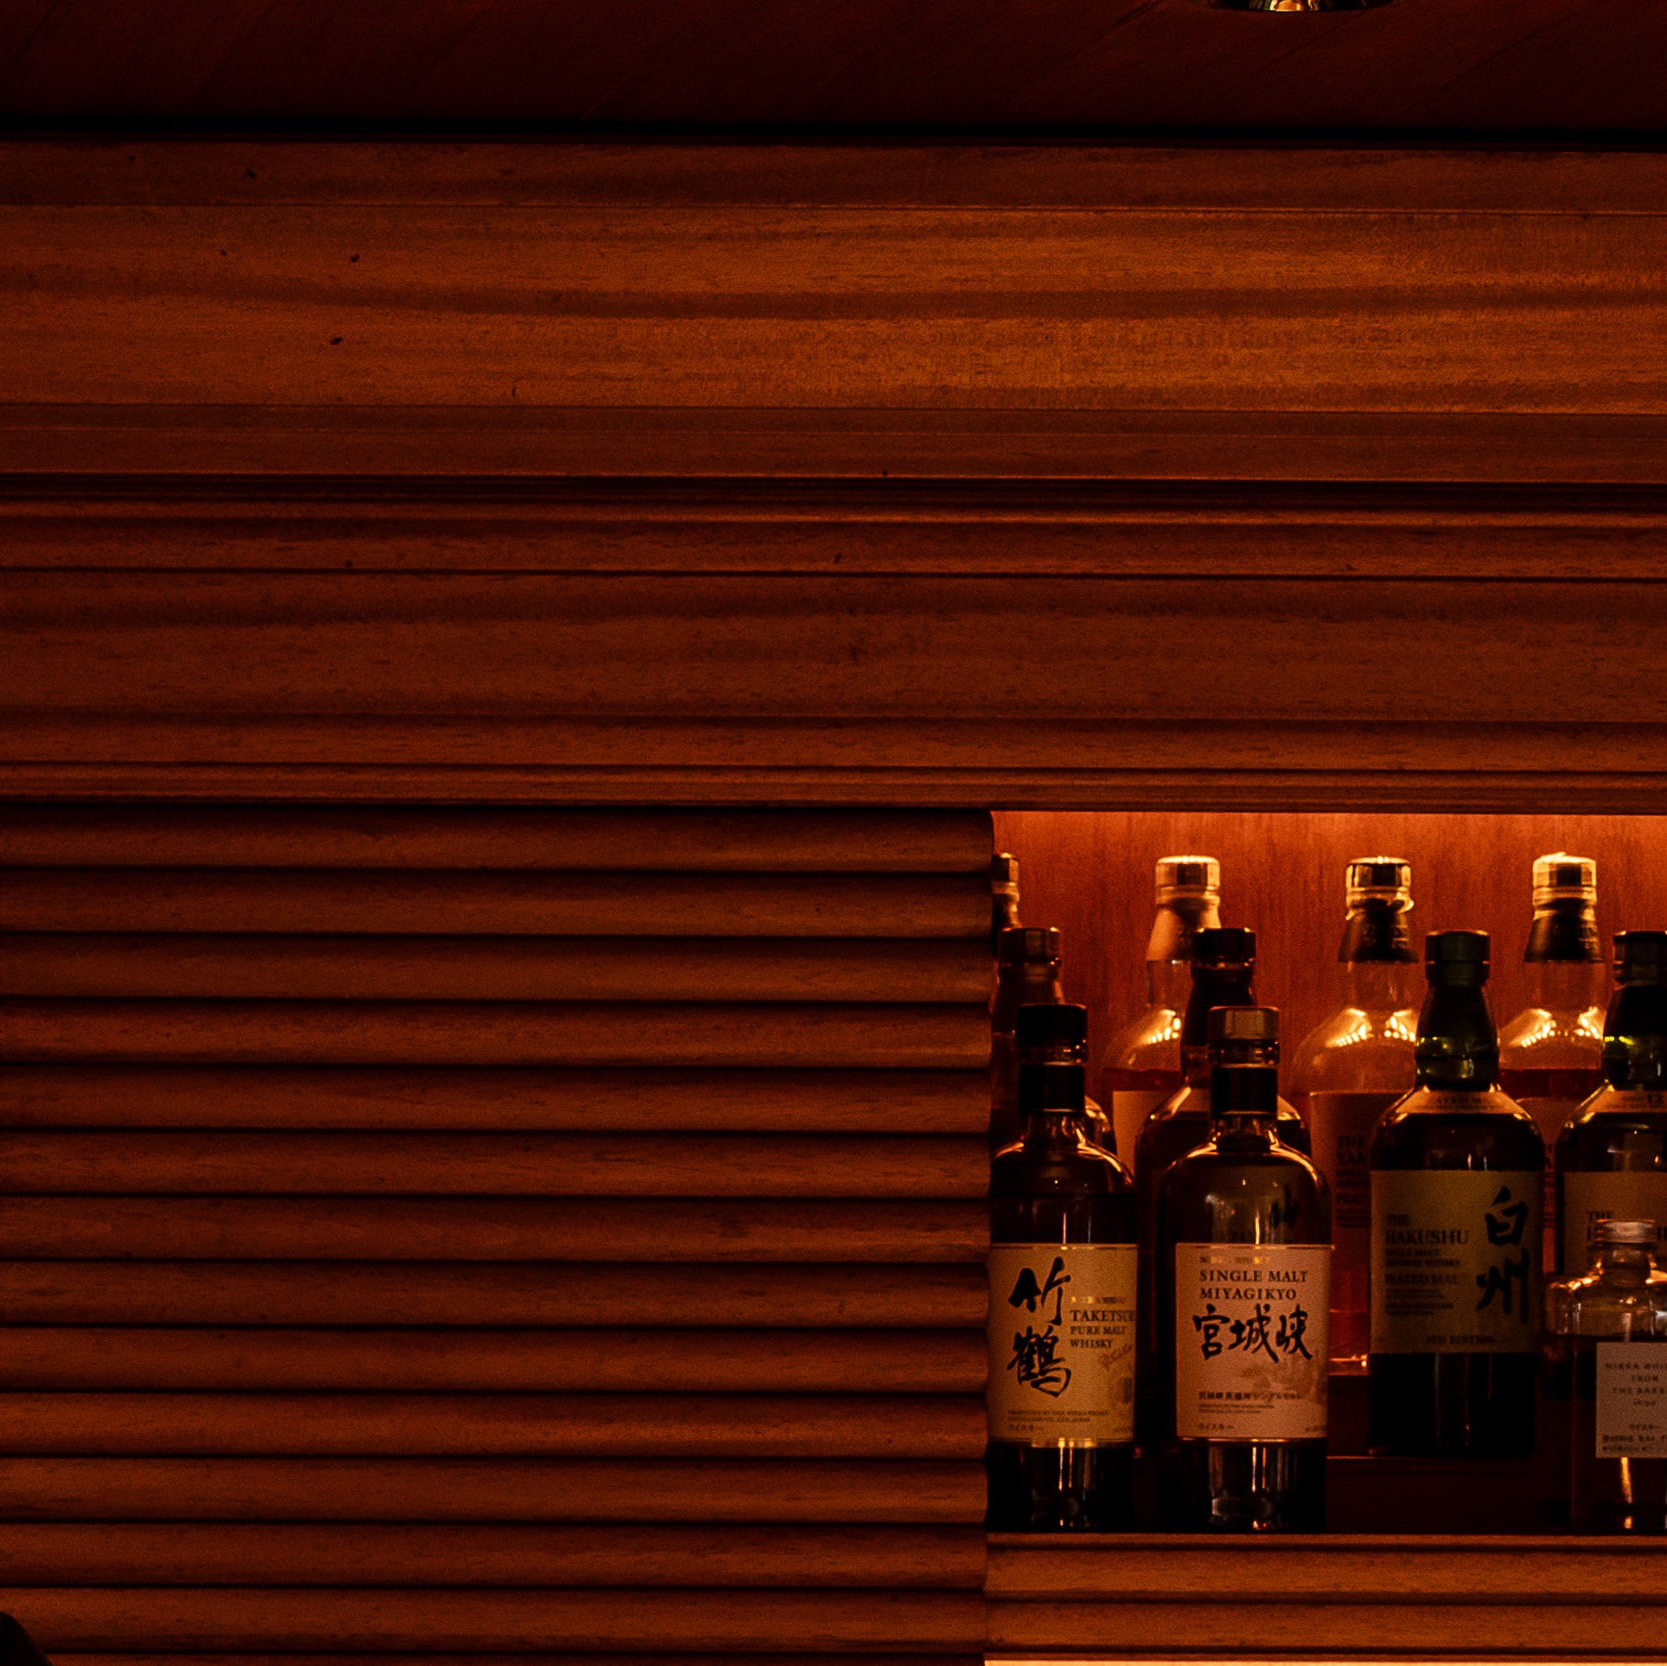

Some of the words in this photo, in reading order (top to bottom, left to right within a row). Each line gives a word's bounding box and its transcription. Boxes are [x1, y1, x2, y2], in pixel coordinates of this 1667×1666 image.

[1387, 1213, 1409, 1227] THE
[1385, 1229, 1469, 1246] HAKUSHU
[1476, 1185, 1530, 1325] 白州
[1199, 1269, 1263, 1283] SINGLE
[1268, 1269, 1309, 1283] MALT
[1199, 1287, 1298, 1300] MIYAGIKYO
[1006, 1255, 1072, 1398] 竹鶴
[1070, 1325, 1101, 1336] PURE
[1102, 1325, 1127, 1336] MALT
[1192, 1302, 1314, 1364] 宮城峡
[1070, 1338, 1114, 1349] WHISKY
